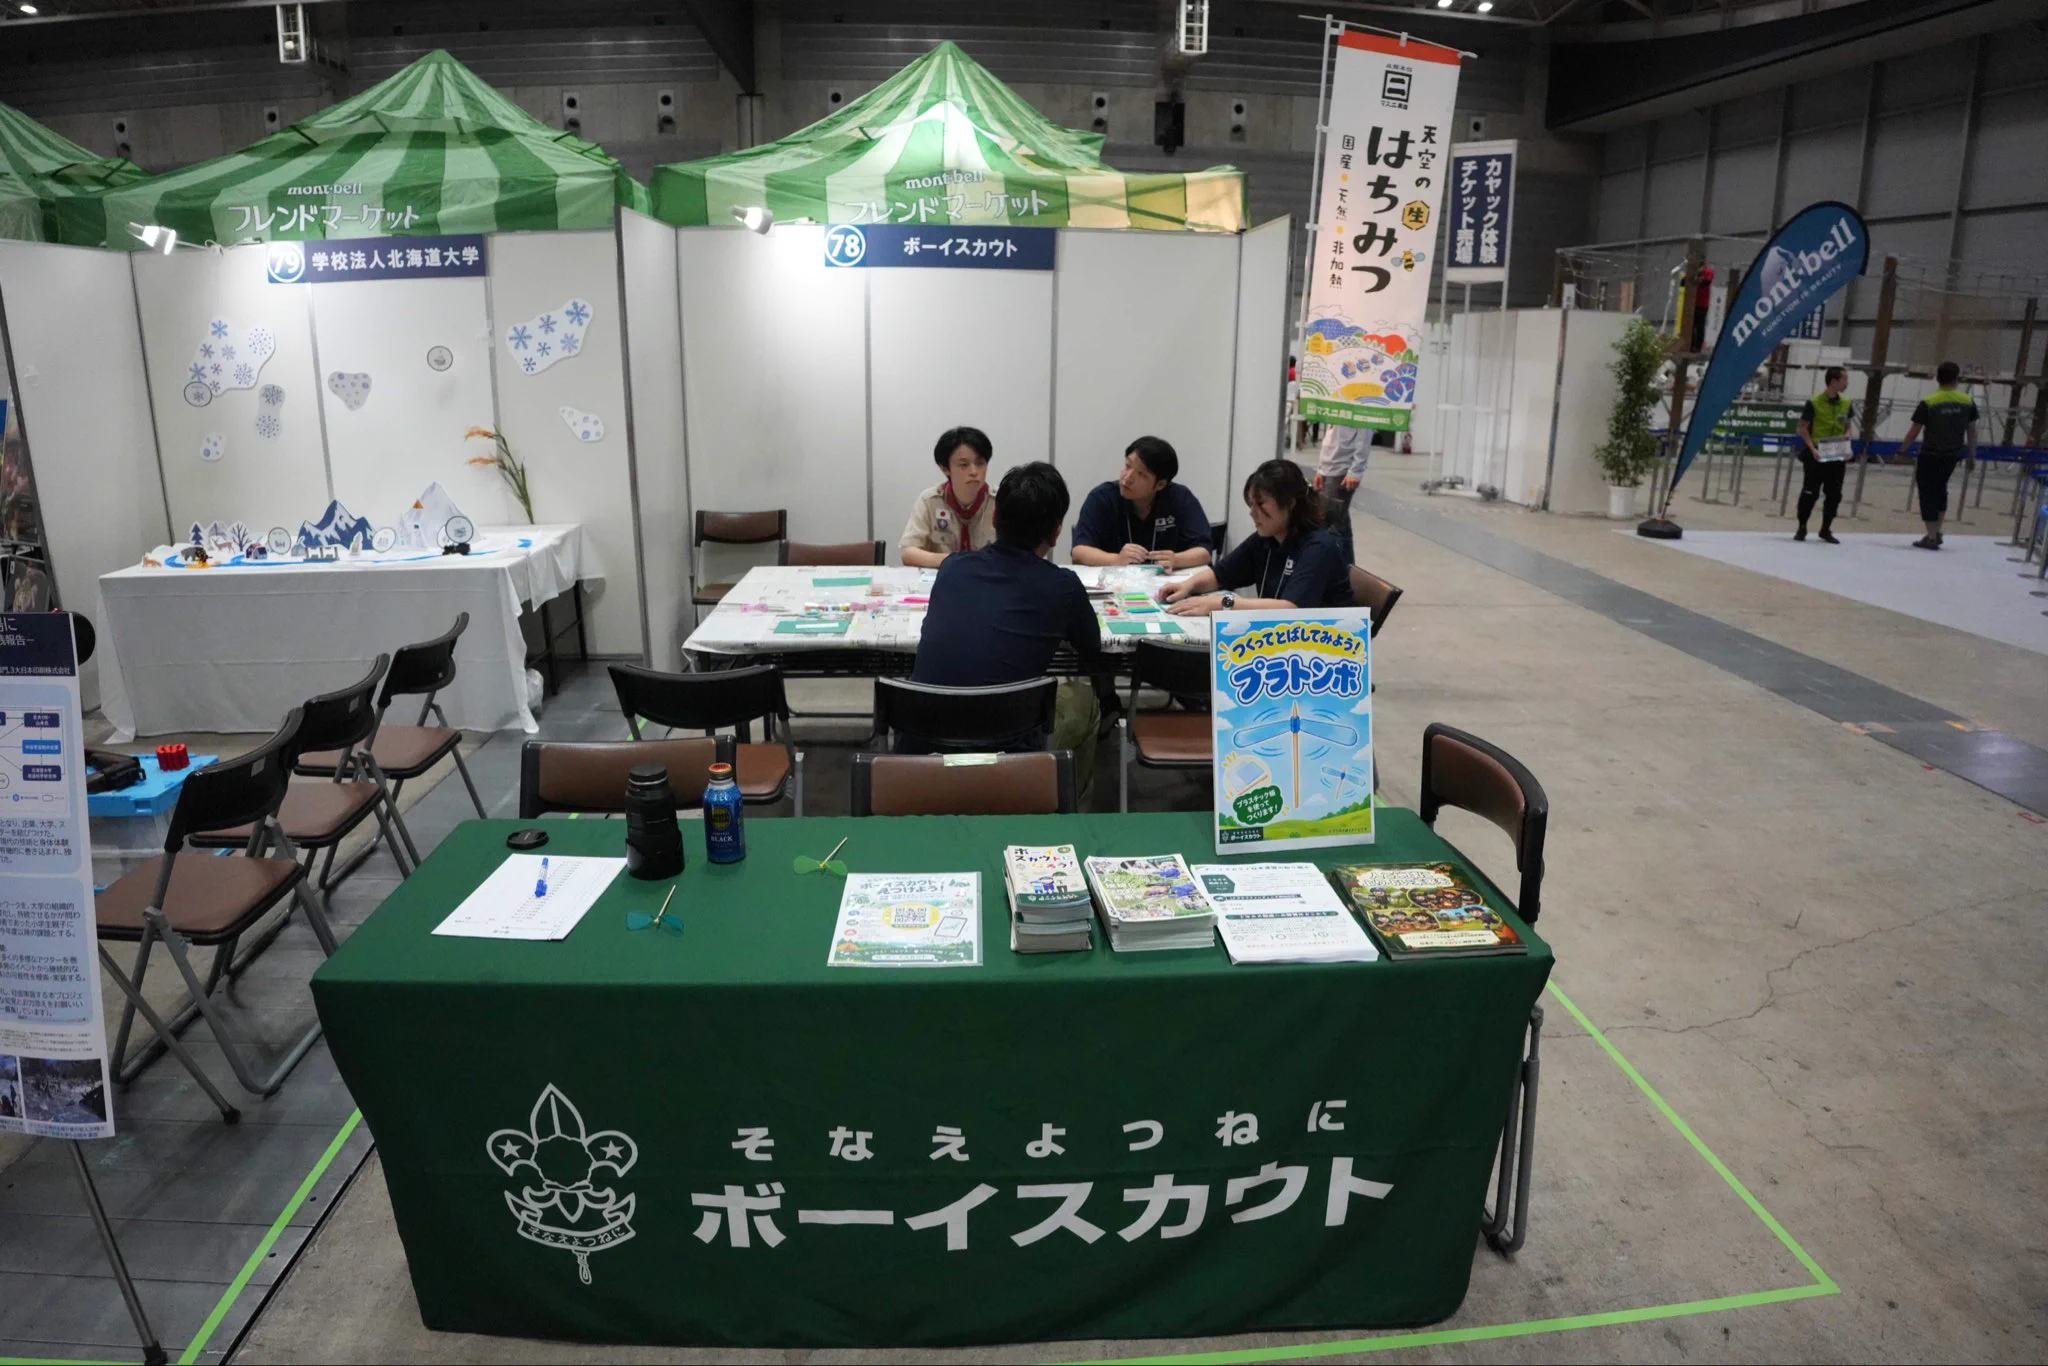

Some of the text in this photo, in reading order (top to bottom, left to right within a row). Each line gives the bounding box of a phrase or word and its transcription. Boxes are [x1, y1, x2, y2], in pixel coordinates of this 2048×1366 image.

[1414, 125, 1438, 189] 天空の
[228, 204, 420, 232] フレンドマーケット
[846, 190, 1049, 224] フレンドマーケット
[1351, 126, 1415, 294] はちみつ
[1455, 160, 1478, 264] チケット売場
[1479, 159, 1502, 263] カヤック体験
[273, 251, 298, 275] 79
[311, 246, 480, 272] 学校法人北海道大学
[829, 234, 860, 258] 78
[903, 237, 1018, 258] ボーイスカウト
[1232, 626, 1361, 658] つくってとばしてみよう!
[1231, 656, 1362, 705] プラトンボ
[732, 1100, 1347, 1162] そなえよつねに
[691, 1157, 1395, 1252] ボーイスカウト
[527, 1225, 627, 1249] そなえよつねに
